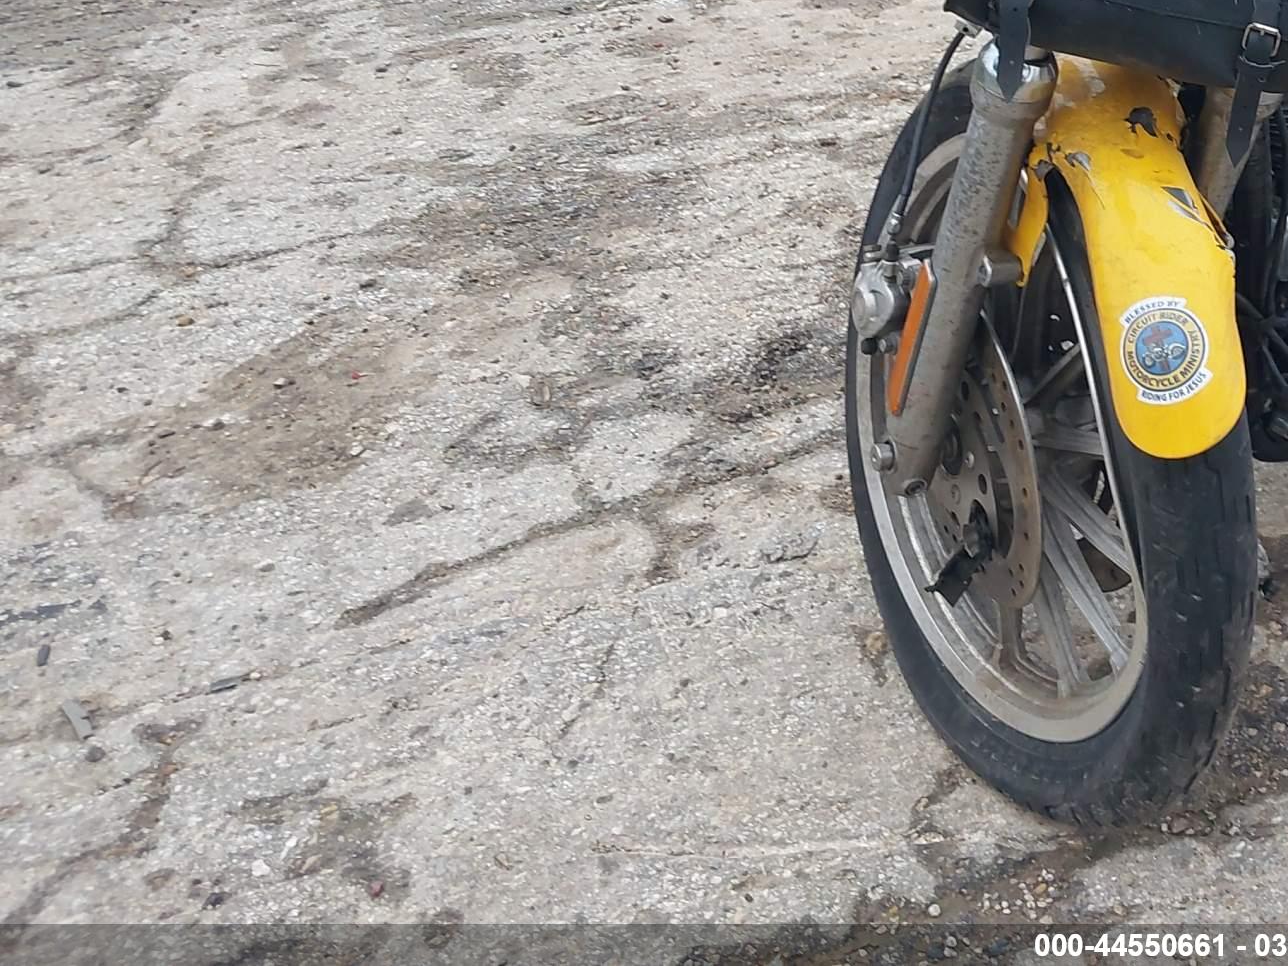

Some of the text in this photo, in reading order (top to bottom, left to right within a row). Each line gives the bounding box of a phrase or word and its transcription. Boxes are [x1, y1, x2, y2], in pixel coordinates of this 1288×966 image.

[1124, 300, 1181, 324] BLESSED BY
[1128, 312, 1189, 344] CIRCUIT RIDER
[1127, 351, 1181, 387] MOTORCYCLE
[1141, 371, 1208, 402] RIDING FOR JESUS
